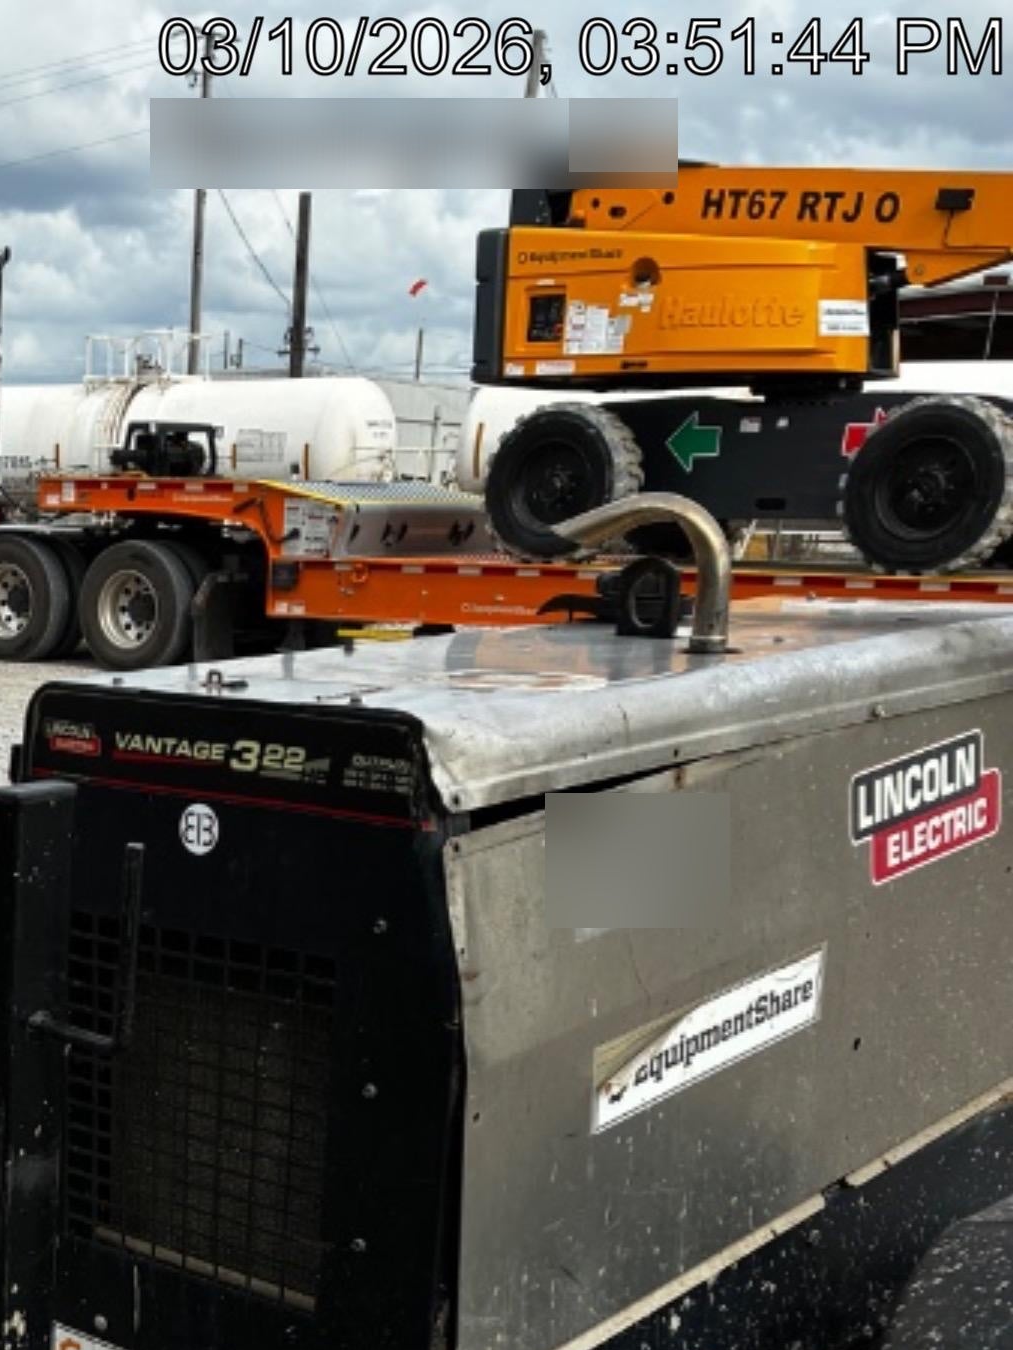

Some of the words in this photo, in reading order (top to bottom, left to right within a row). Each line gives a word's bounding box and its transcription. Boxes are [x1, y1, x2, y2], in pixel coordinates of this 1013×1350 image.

[701, 188, 787, 220] HT67
[797, 190, 864, 223] RTJ
[114, 731, 228, 761] VANTAGE
[229, 739, 307, 773] 322
[857, 743, 976, 830] LINCOLN
[886, 797, 988, 868] ELECTRIC
